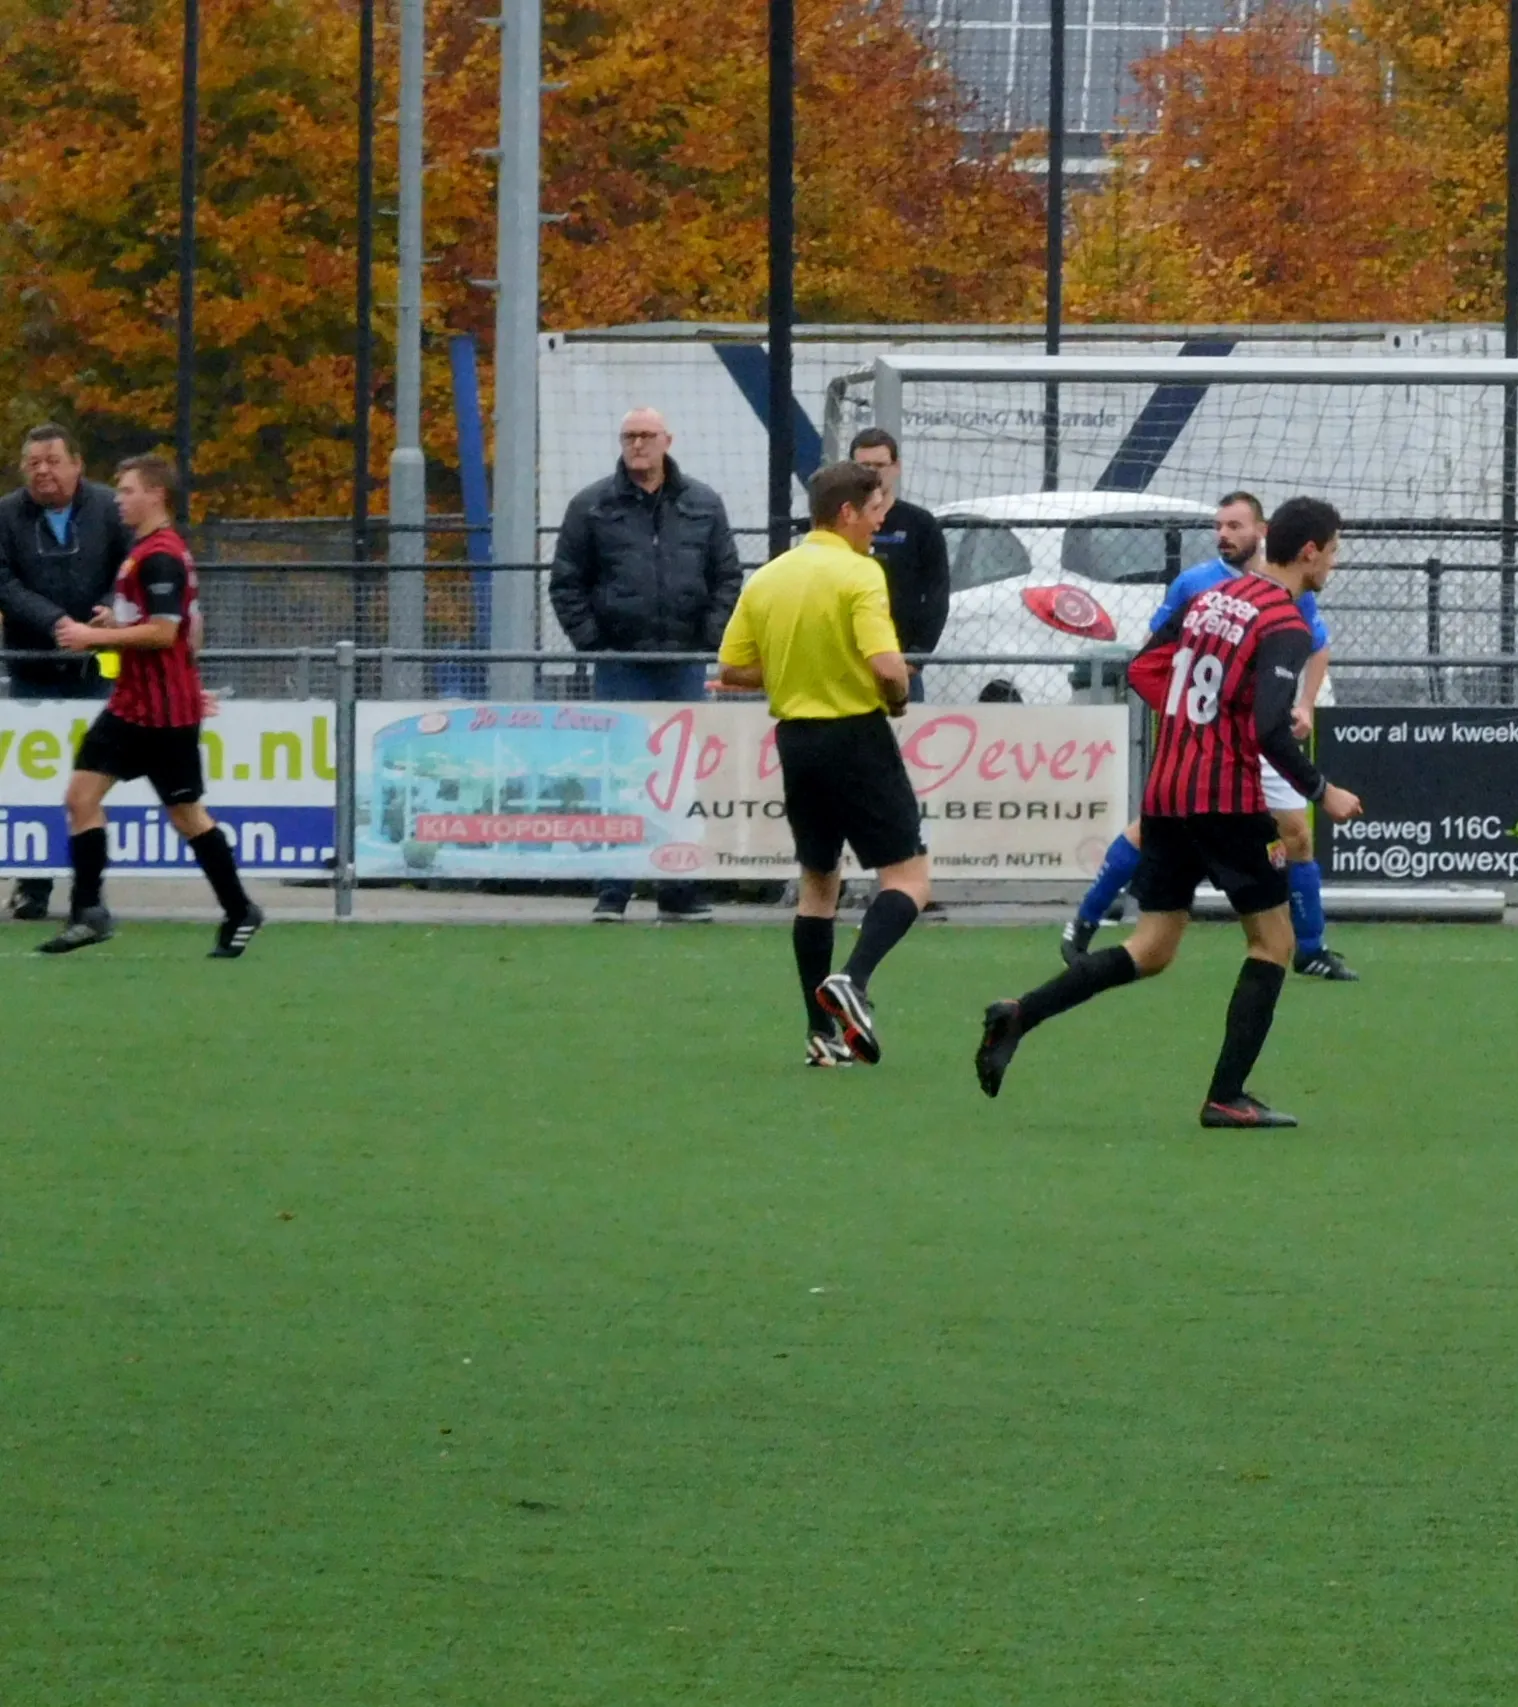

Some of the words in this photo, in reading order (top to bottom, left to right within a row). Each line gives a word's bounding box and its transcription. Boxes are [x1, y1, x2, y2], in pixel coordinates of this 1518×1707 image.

[1165, 647, 1224, 725] 18
[1333, 725, 1382, 743] voor
[1387, 722, 1407, 743] al
[1414, 725, 1446, 743] uw
[646, 708, 727, 811] Jo
[900, 714, 1117, 796] Oever
[422, 819, 469, 838] KIA
[477, 819, 638, 838] TOPDEALER
[1332, 817, 1432, 845] Reeweg
[1440, 815, 1502, 840] 116C
[1005, 852, 1063, 867] NUTH
